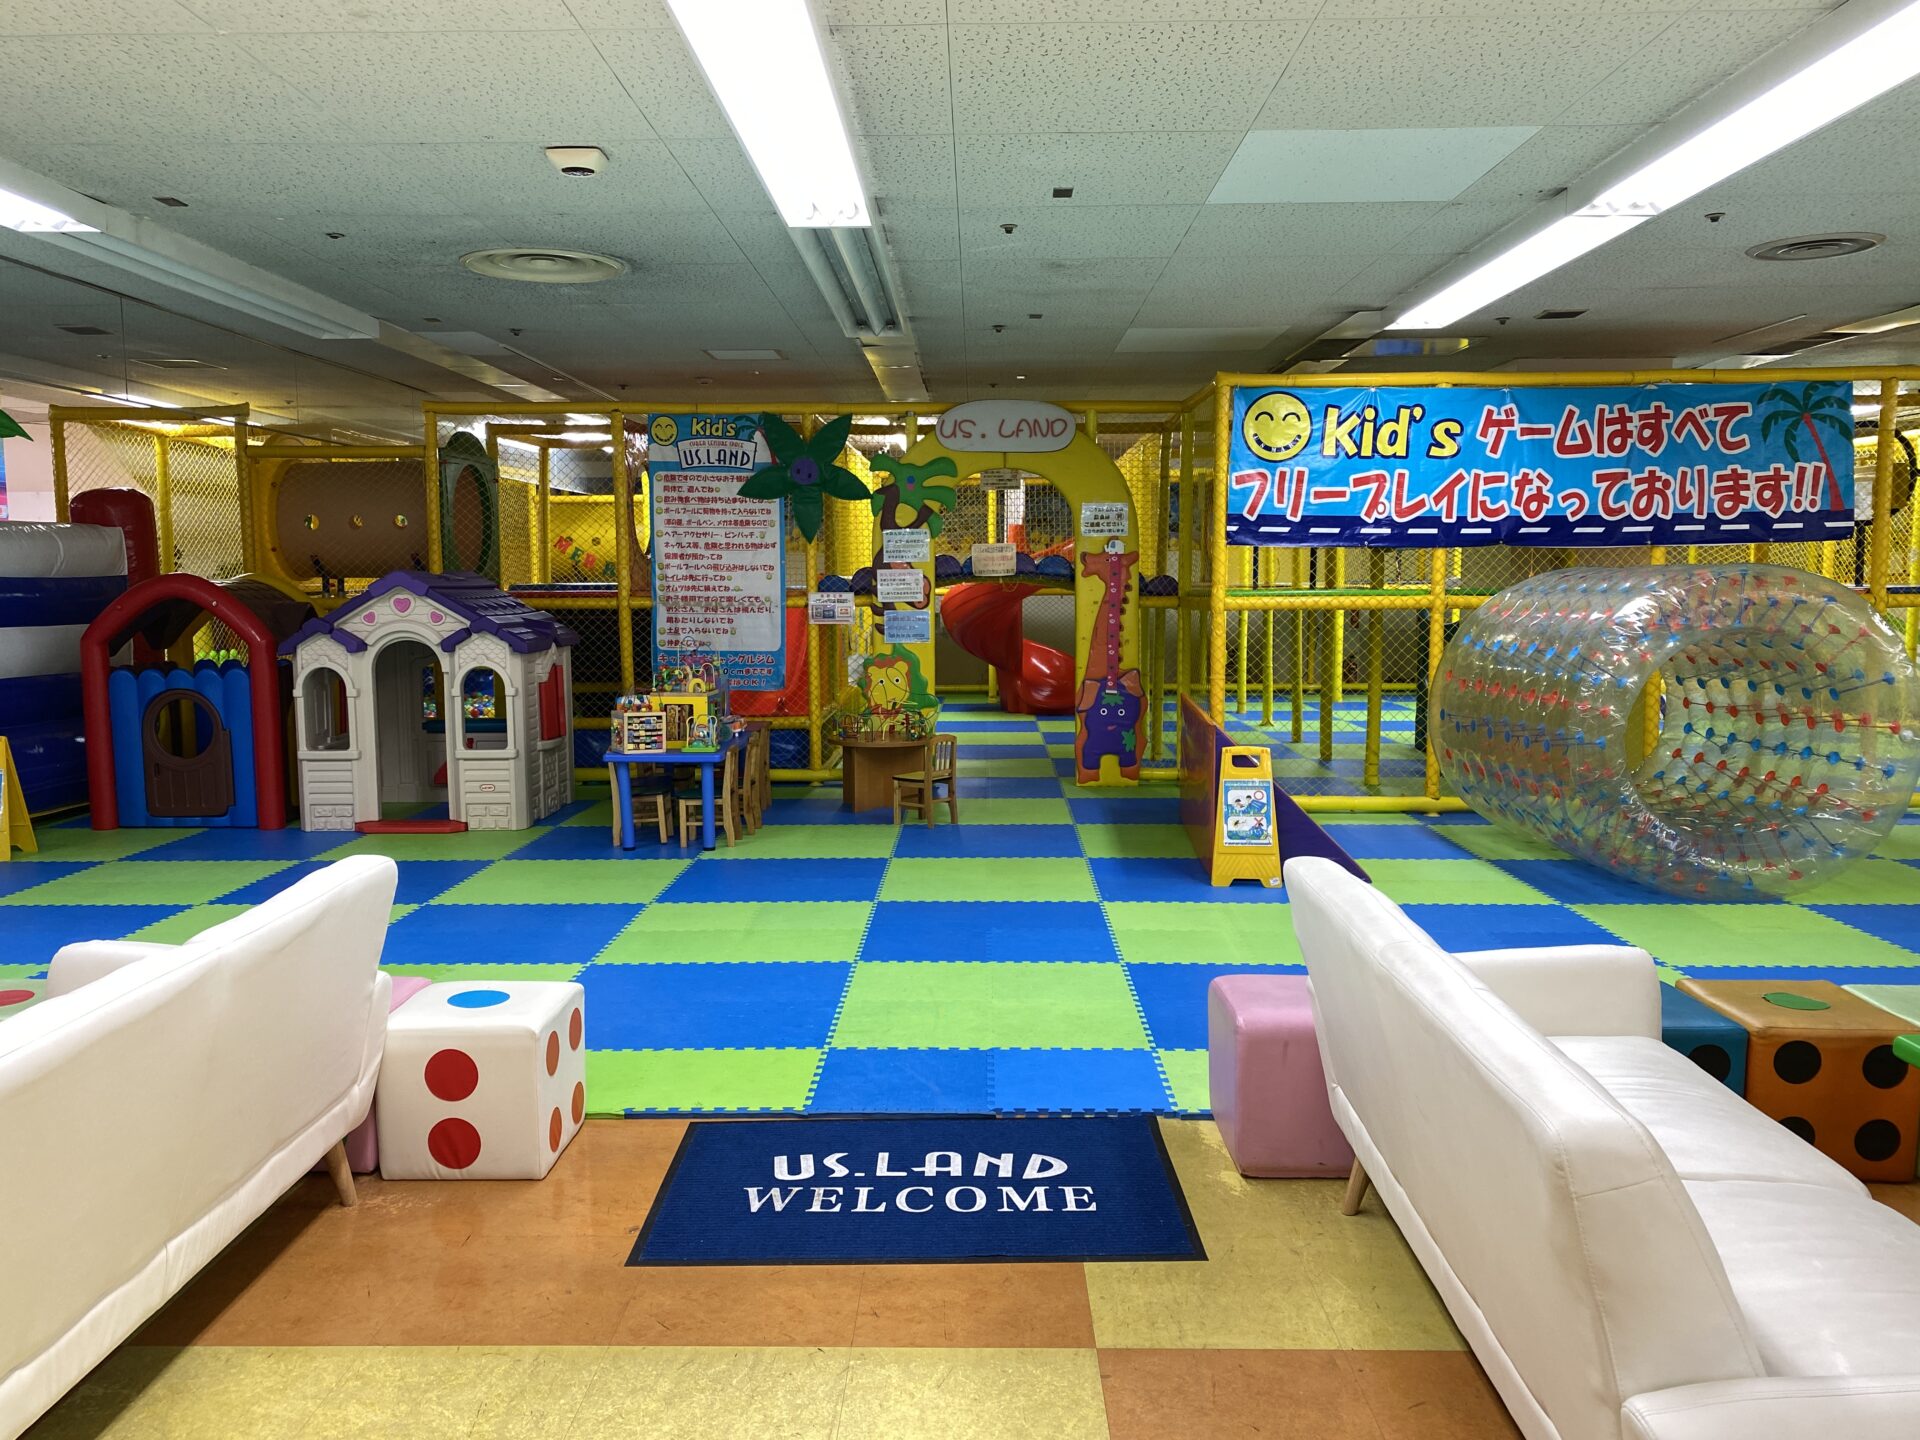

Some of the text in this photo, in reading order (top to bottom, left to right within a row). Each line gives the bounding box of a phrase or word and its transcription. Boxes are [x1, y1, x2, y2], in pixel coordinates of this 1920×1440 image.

[691, 417, 737, 437] Kid's
[940, 418, 1068, 439] US. LAND
[1322, 403, 1751, 458] Kid's ゲームはすべて
[683, 449, 750, 467] US.LAND
[1233, 463, 1824, 521] フリープレイになっております!!
[773, 1150, 1069, 1181] US.LAND
[743, 1185, 1097, 1214] WELCOME
